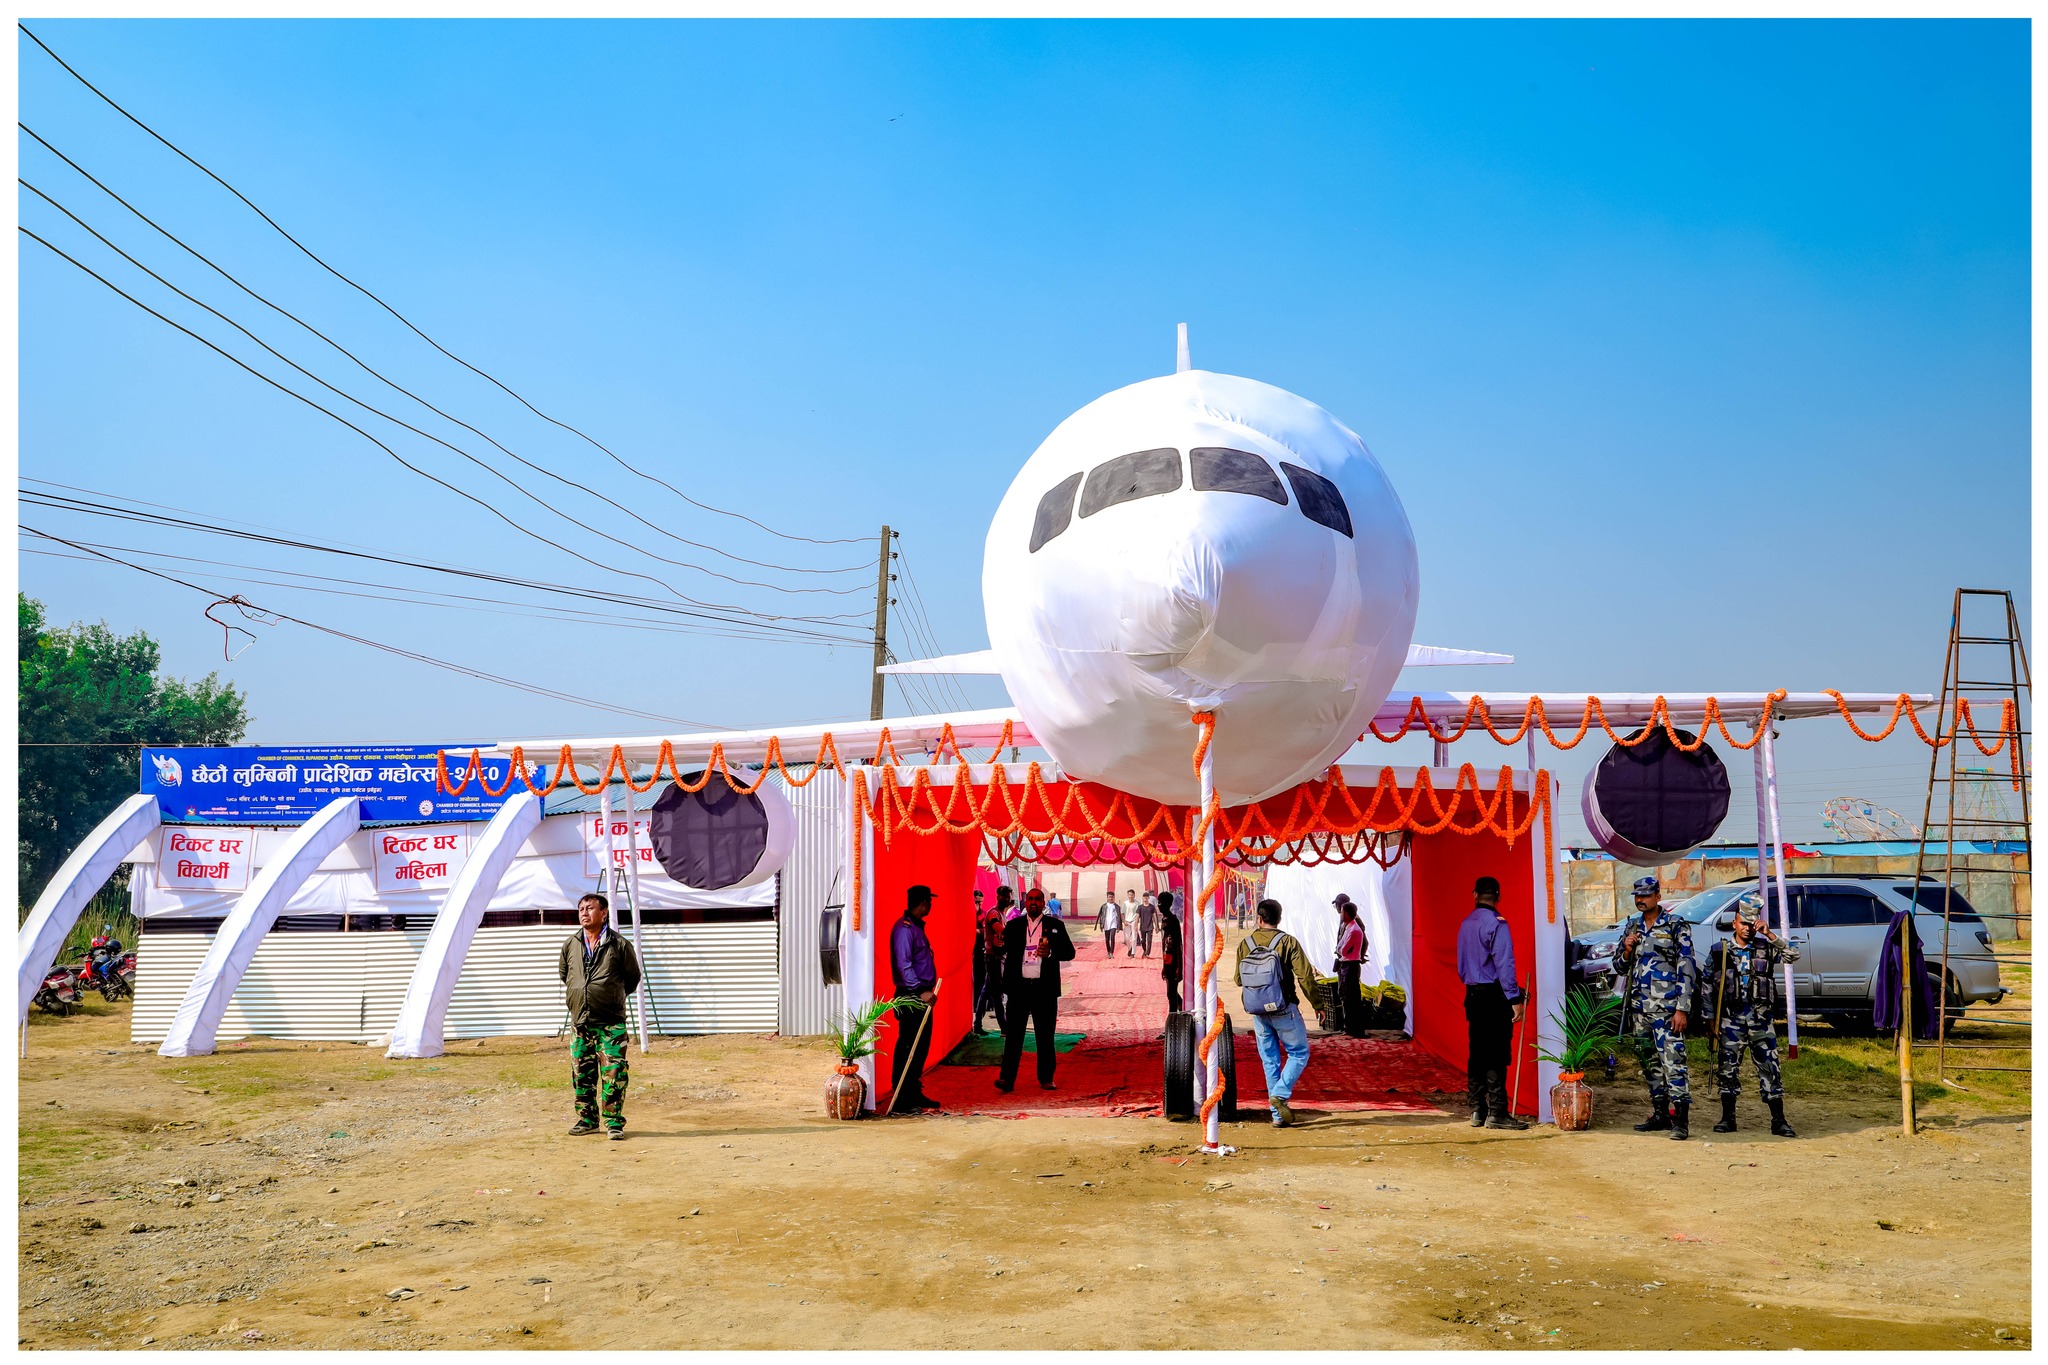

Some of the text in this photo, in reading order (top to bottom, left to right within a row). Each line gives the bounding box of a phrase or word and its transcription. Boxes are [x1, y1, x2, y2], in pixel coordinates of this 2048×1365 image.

[233, 763, 298, 787] लुम्बिनी
[303, 763, 374, 784] प्रादेशिक
[378, 762, 500, 784] महोत्स-२०८०
[170, 833, 244, 854] टिकट घर
[382, 834, 458, 855] टिकट घर
[177, 859, 230, 879] विद्यार्थी
[395, 860, 448, 880] महिला
